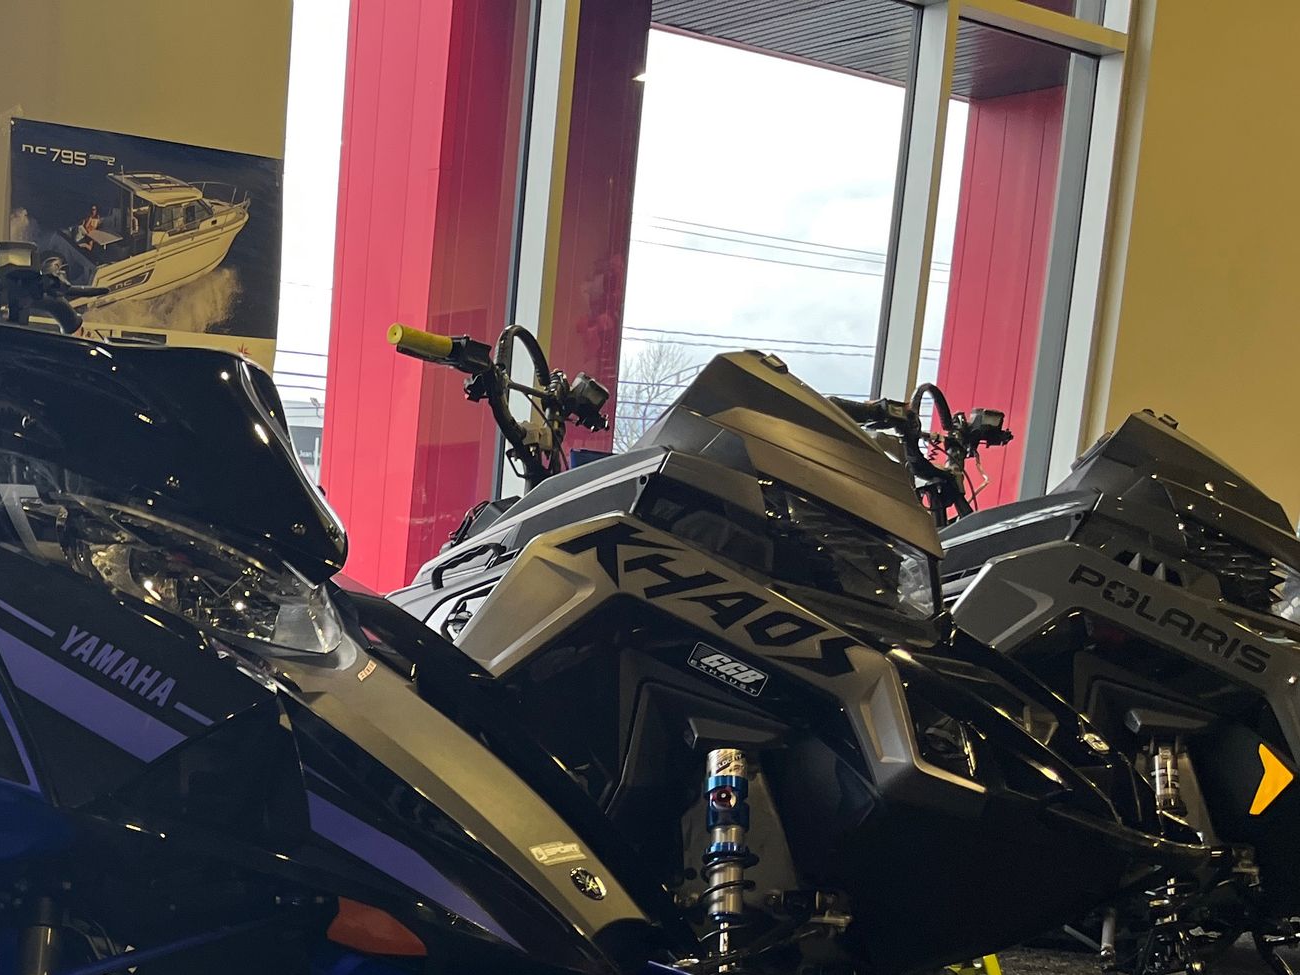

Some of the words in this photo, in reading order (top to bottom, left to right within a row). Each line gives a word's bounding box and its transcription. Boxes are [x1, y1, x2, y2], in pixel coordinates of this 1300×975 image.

[49, 147, 87, 166] 795
[556, 521, 868, 678] KHAOS
[1068, 563, 1271, 674] POLARIS
[60, 624, 177, 708] YAMAHA
[689, 658, 757, 694] EXHAUST
